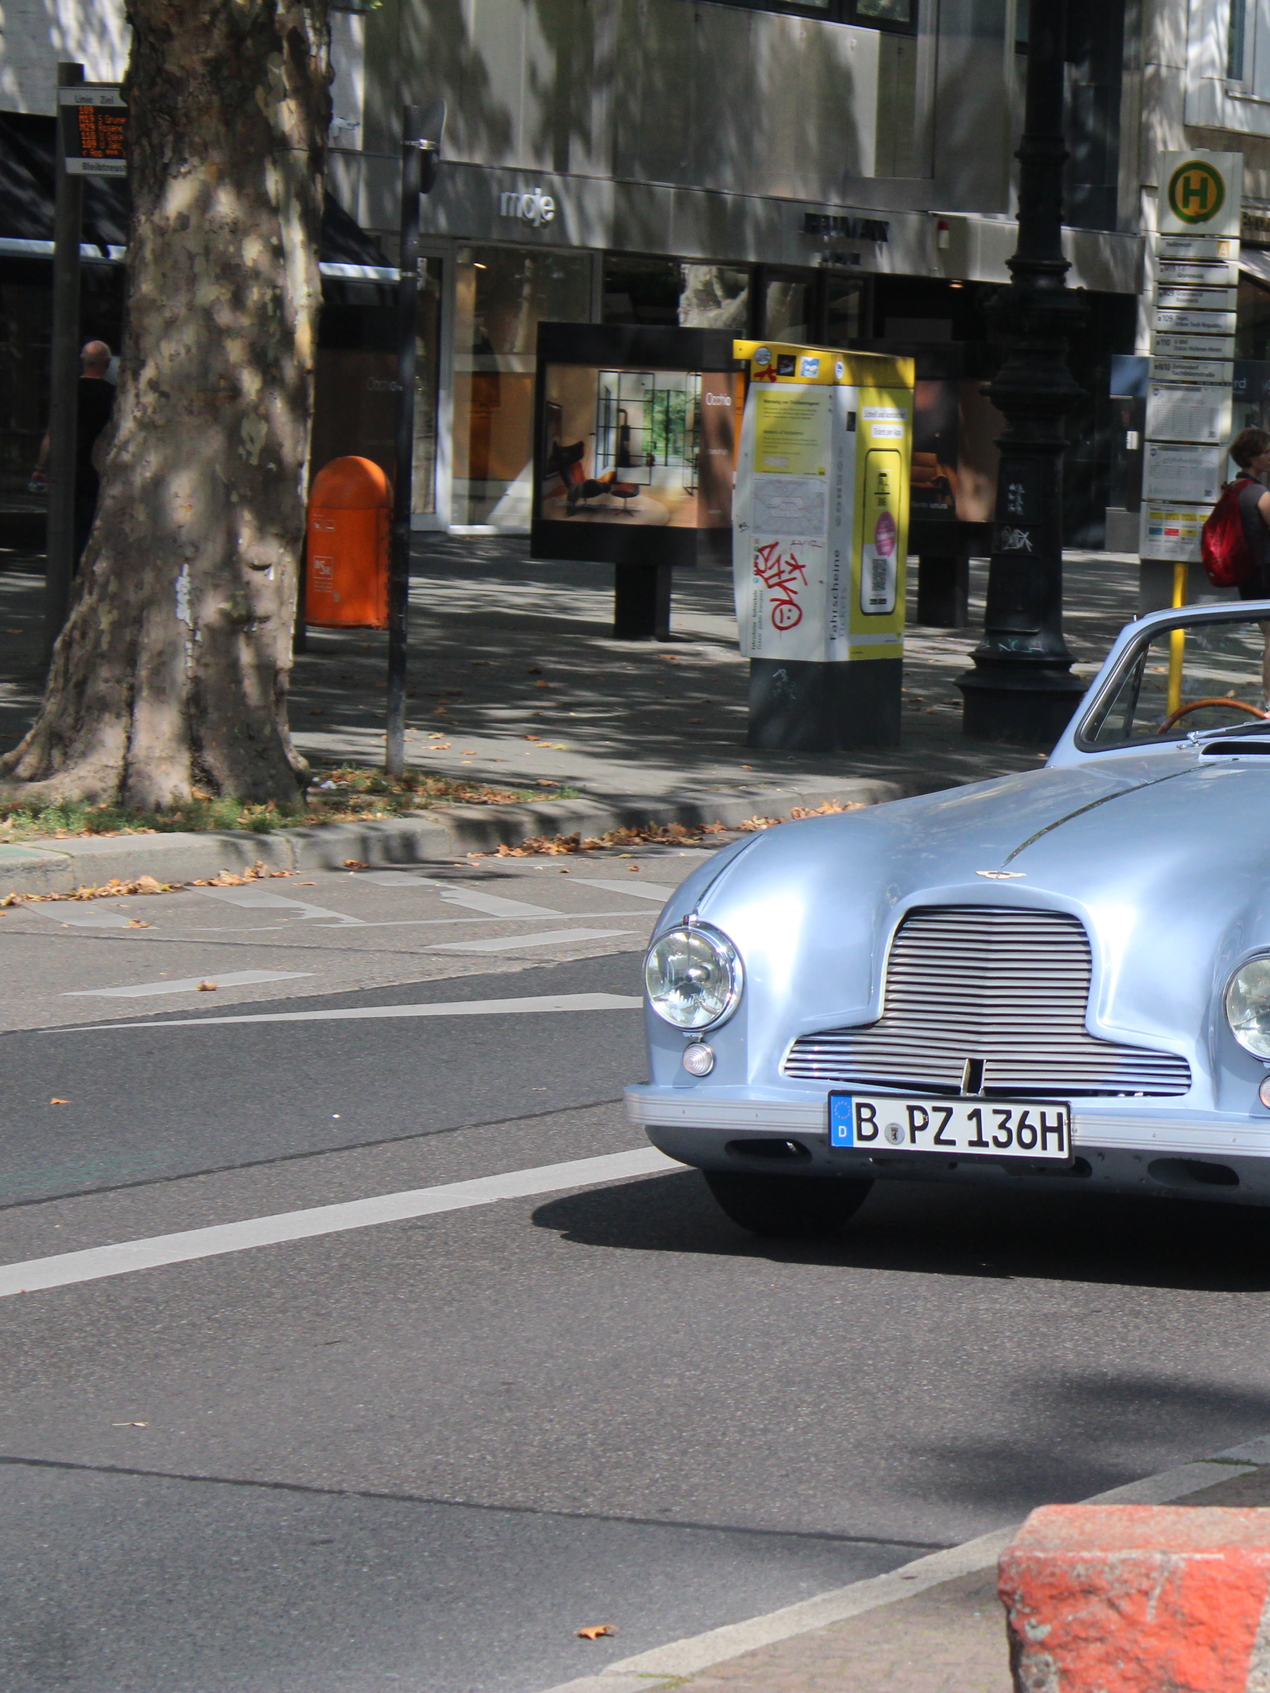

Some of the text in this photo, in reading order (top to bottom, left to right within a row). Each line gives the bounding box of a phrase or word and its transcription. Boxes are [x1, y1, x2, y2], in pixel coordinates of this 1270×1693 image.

[100, 94, 114, 104] Ziel
[1182, 176, 1208, 210] H
[1162, 314, 1173, 322] 109
[830, 550, 841, 640] Fahrscheine
[838, 586, 847, 638] Tickets
[838, 1125, 847, 1138] D
[855, 1102, 1064, 1152] B PZ 136H
